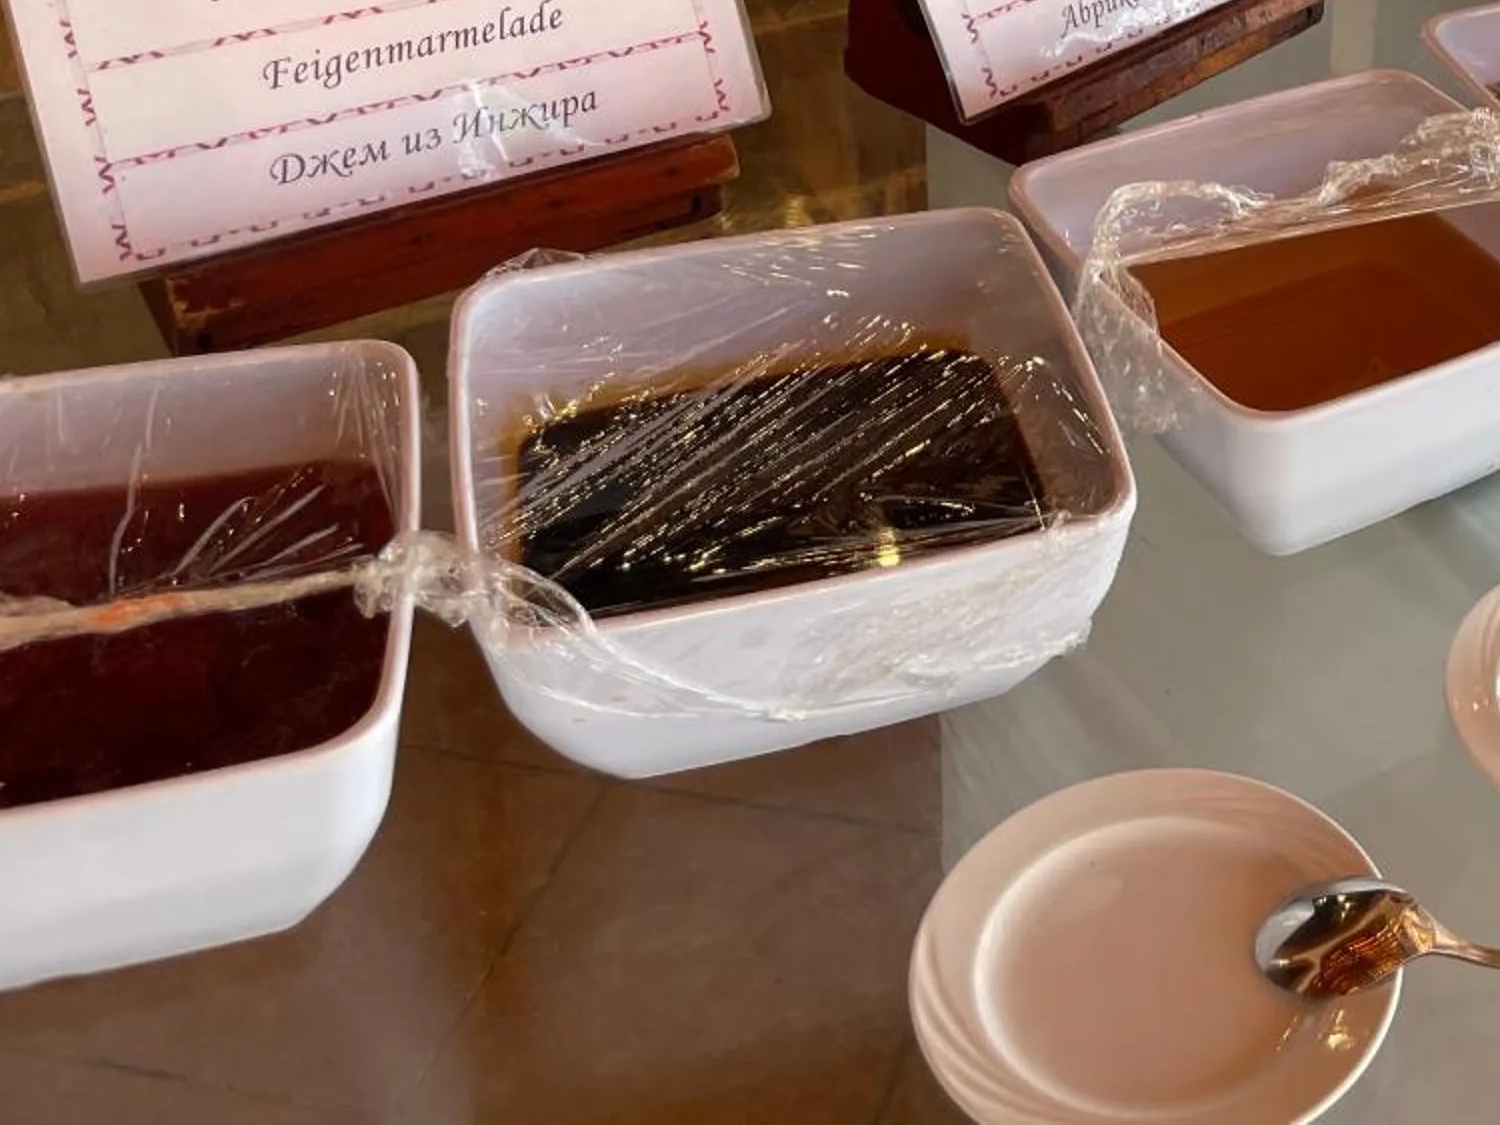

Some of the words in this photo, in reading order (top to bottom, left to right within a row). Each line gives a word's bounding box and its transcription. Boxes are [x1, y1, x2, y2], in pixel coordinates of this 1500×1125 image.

[270, 139, 389, 184] Джем
[401, 127, 442, 155] из
[452, 91, 598, 145] Инжира
